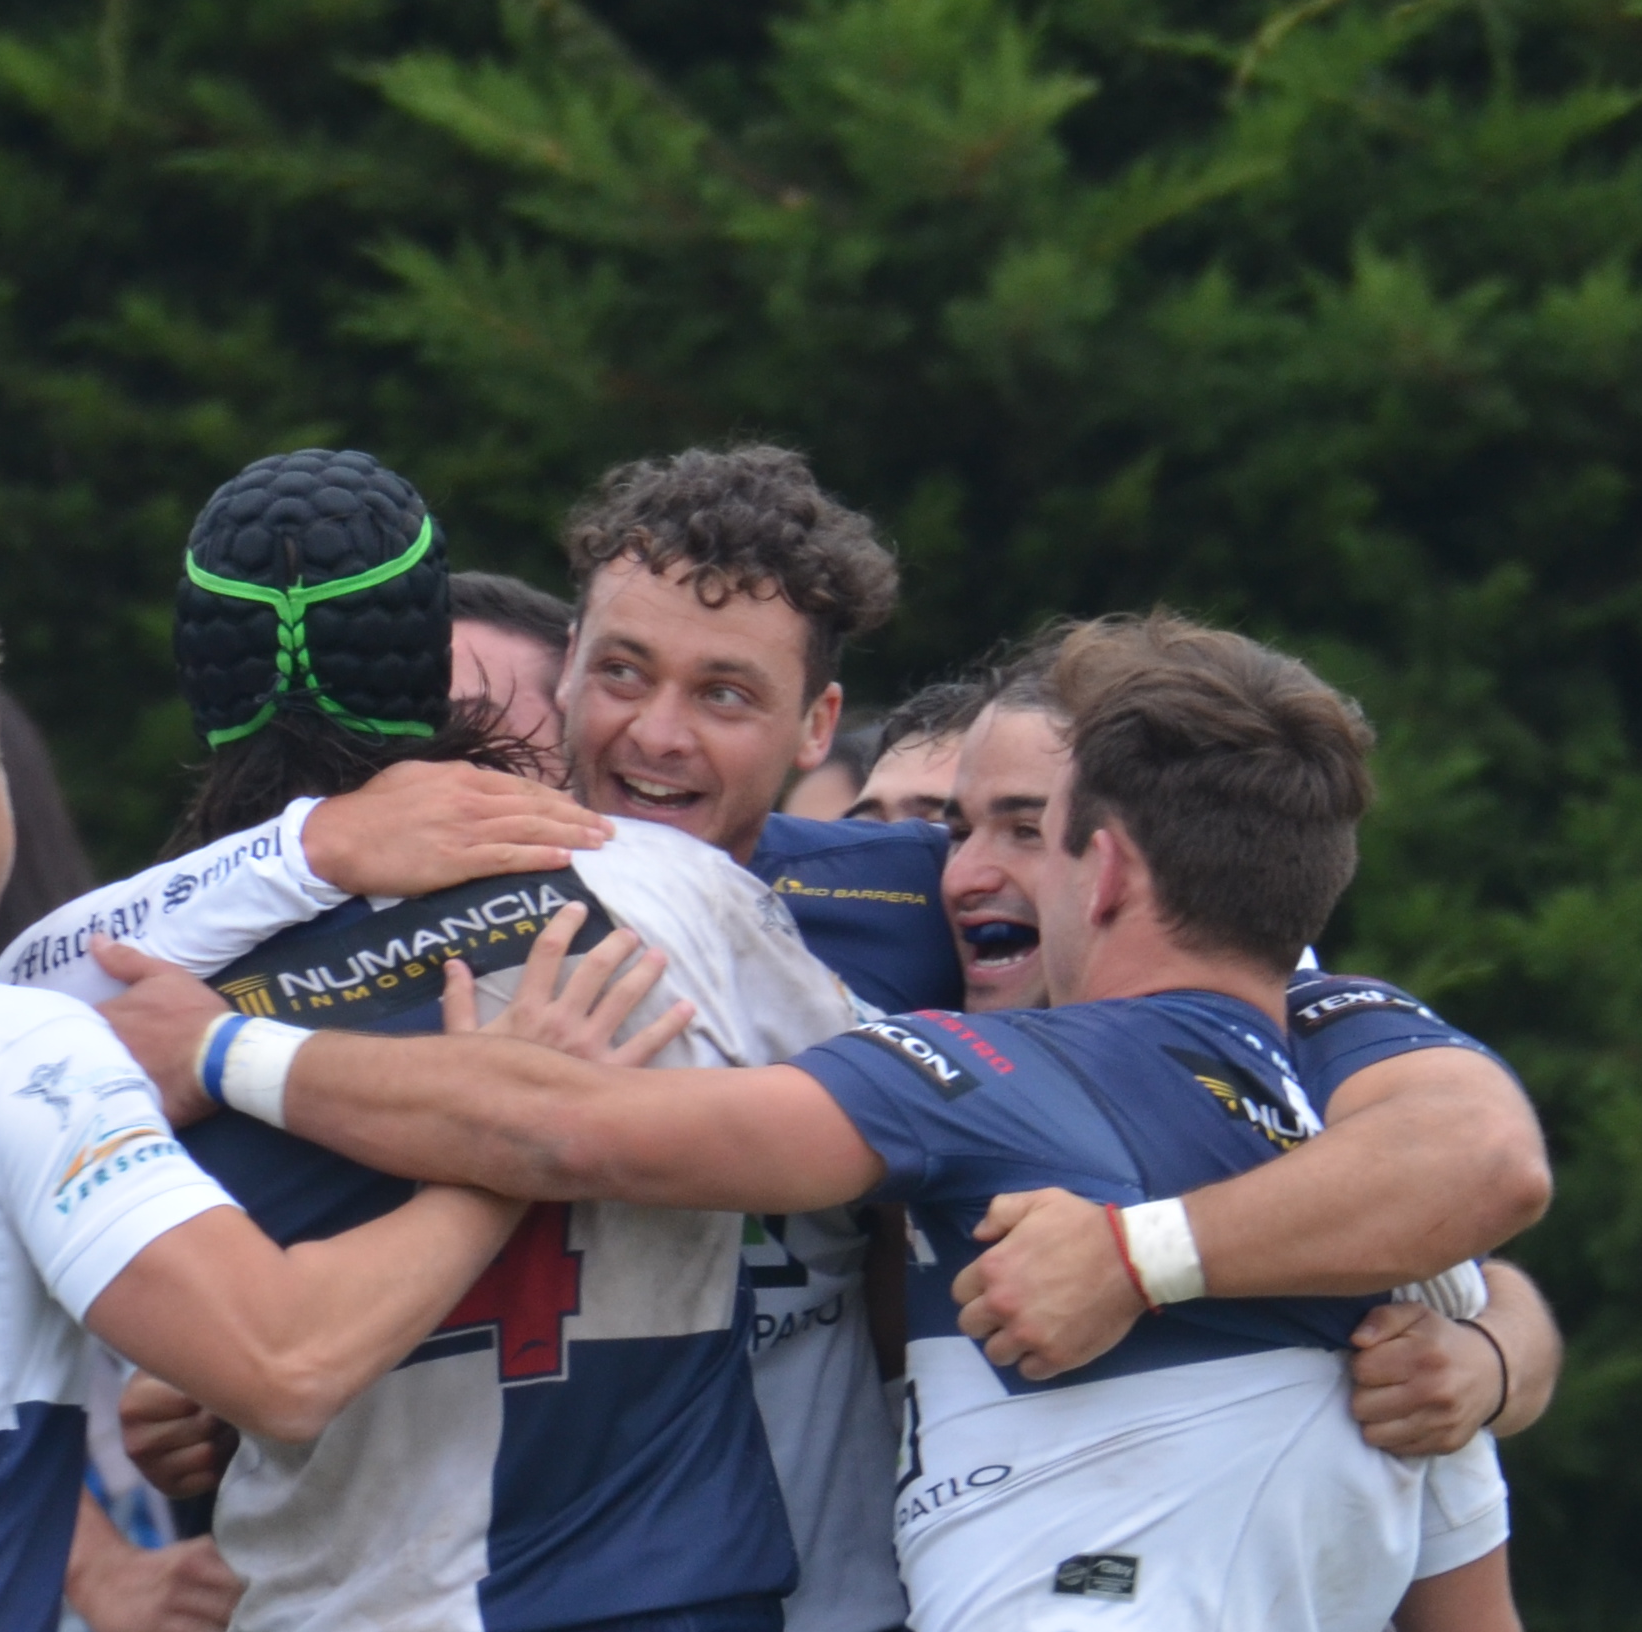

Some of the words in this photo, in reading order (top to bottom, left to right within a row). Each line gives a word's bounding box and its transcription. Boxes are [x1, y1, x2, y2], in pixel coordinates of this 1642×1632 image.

[277, 884, 570, 997] NUMANCIA
[833, 888, 927, 905] BARRERA
[435, 1196, 584, 1384] 4
